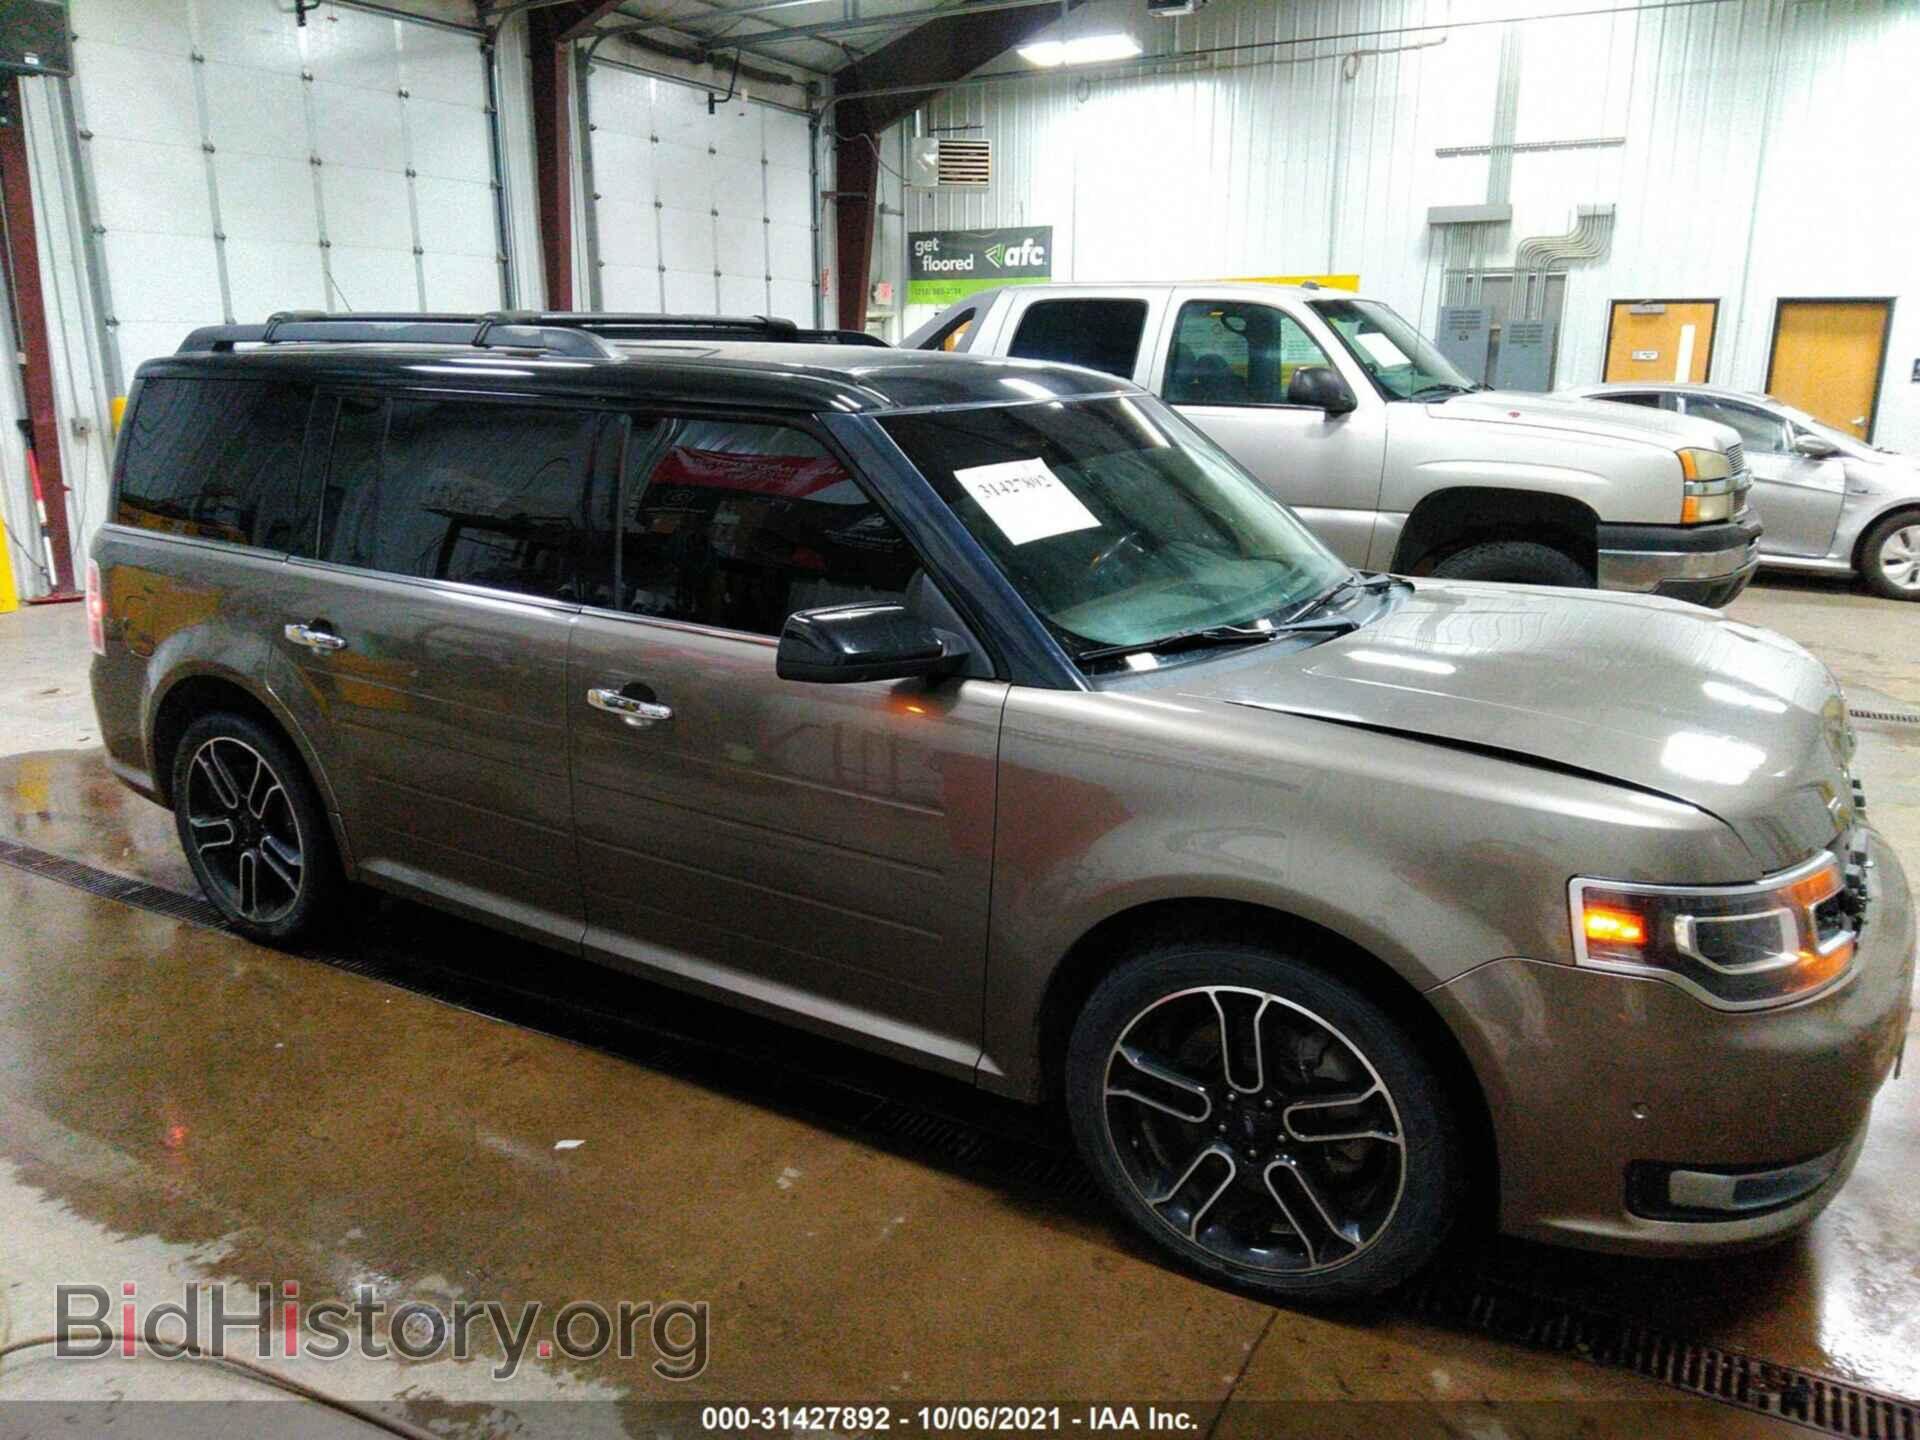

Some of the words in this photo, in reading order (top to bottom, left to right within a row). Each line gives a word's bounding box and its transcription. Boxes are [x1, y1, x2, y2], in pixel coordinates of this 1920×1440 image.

[914, 237, 940, 256] get
[1004, 238, 1045, 266] afc
[922, 253, 974, 271] floored
